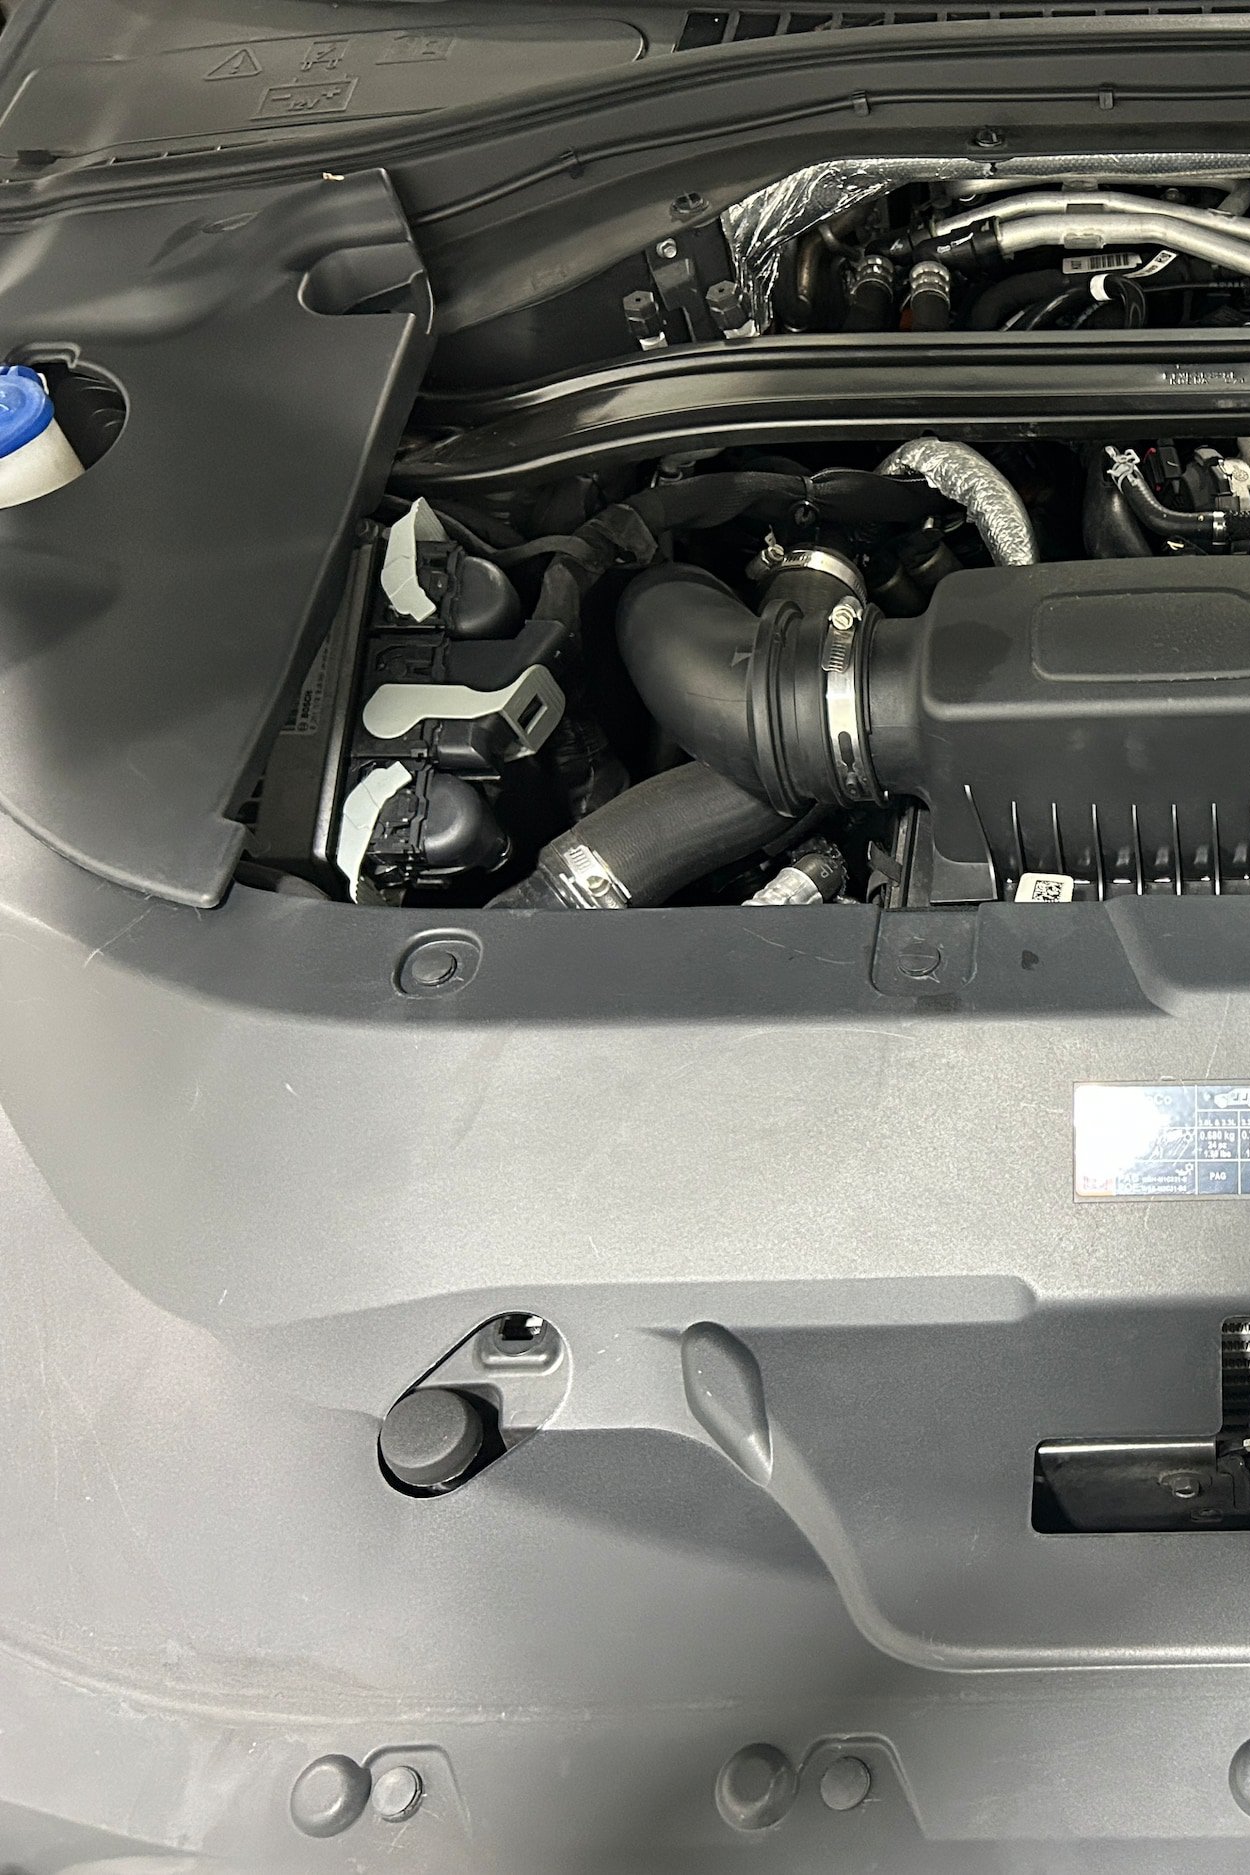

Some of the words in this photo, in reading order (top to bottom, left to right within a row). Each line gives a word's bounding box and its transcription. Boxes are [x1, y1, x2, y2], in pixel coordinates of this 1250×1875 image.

[301, 690, 312, 718] BOSCH
[1224, 1130, 1236, 1142] kg
[1209, 1172, 1226, 1180] PAG
